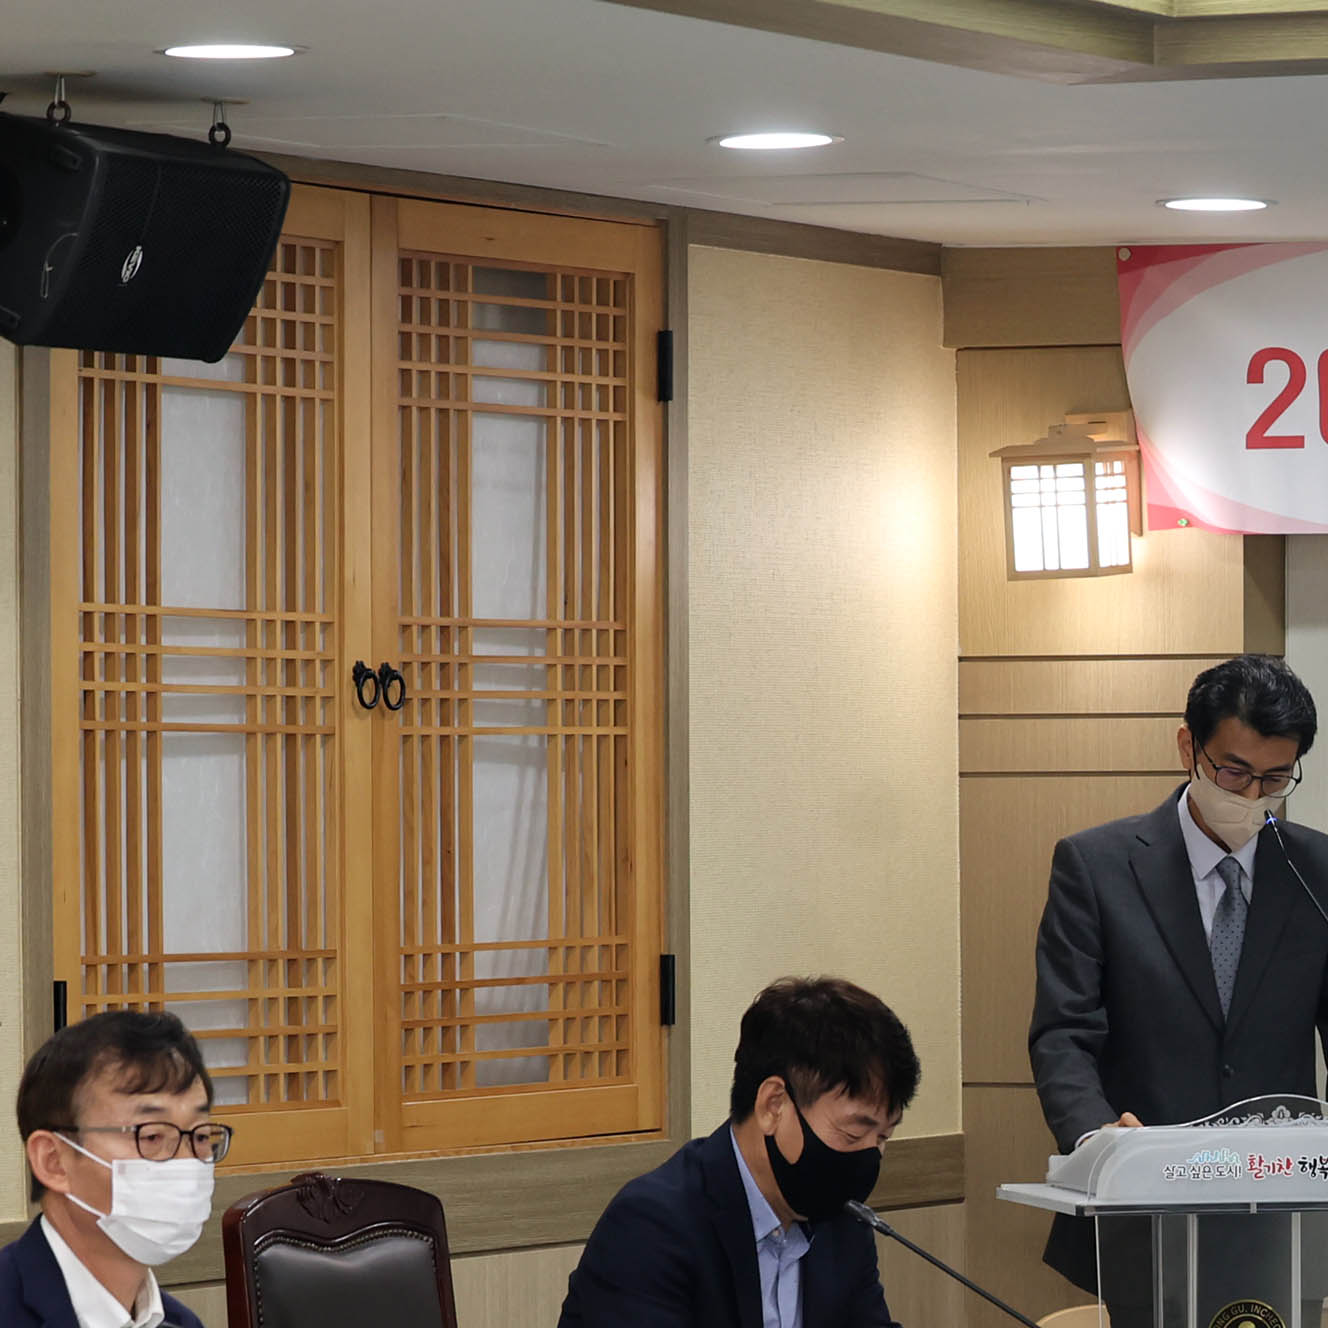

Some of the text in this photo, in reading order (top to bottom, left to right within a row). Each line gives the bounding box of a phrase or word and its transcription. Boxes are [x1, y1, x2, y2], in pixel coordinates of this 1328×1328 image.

[1163, 1165, 1187, 1179] 살고
[1190, 1165, 1213, 1180] 싶은
[1247, 1153, 1292, 1180] 활기찬
